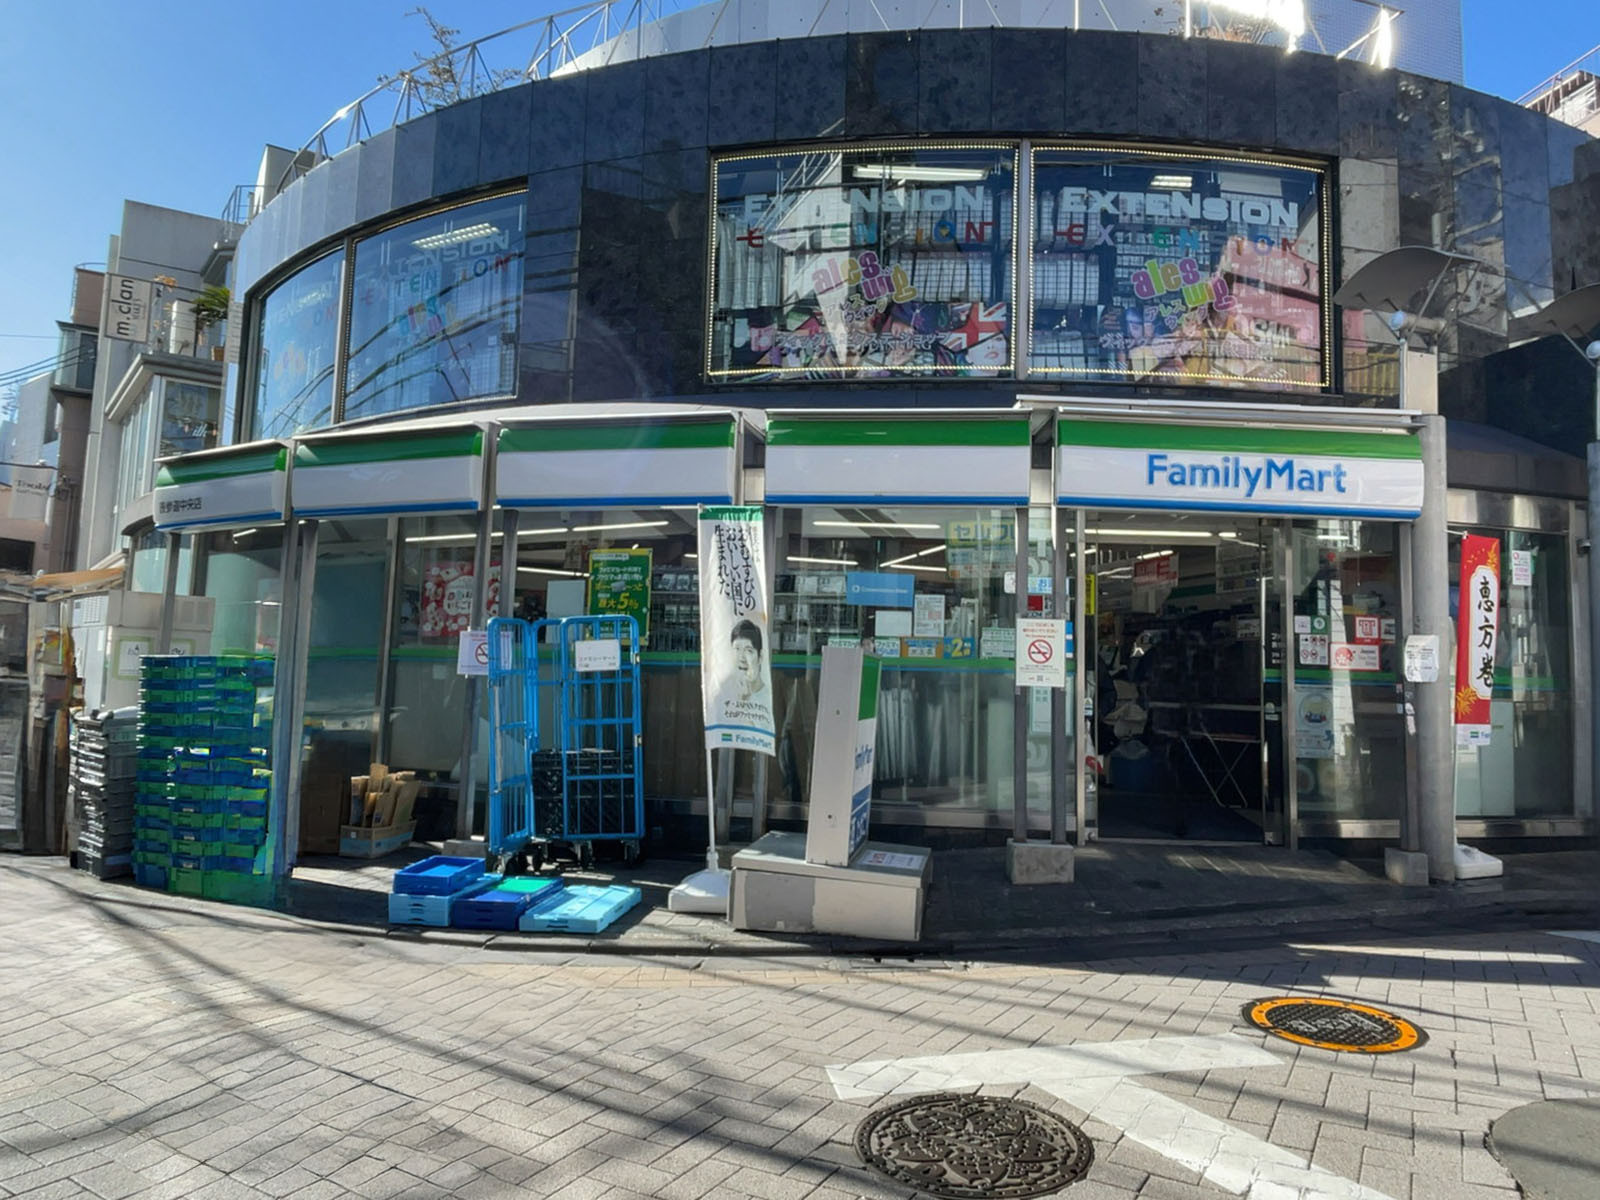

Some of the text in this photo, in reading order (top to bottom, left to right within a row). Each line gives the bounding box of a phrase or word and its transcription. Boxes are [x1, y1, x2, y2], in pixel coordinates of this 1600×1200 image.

[744, 186, 985, 219] EXNSION
[1061, 187, 1298, 228] EXTENSION
[736, 221, 996, 247] EENION
[811, 251, 881, 298] ales
[1130, 257, 1201, 300] ales
[1180, 275, 1239, 313] wig
[111, 279, 134, 337] m.clan
[1145, 299, 1187, 323] アレス
[1147, 454, 1347, 497] FamilyMart
[726, 527, 744, 617] おいしい国に
[737, 527, 756, 612] おむすびの
[1476, 575, 1495, 688] 恵方巻
[735, 734, 772, 749] FamilyMart
